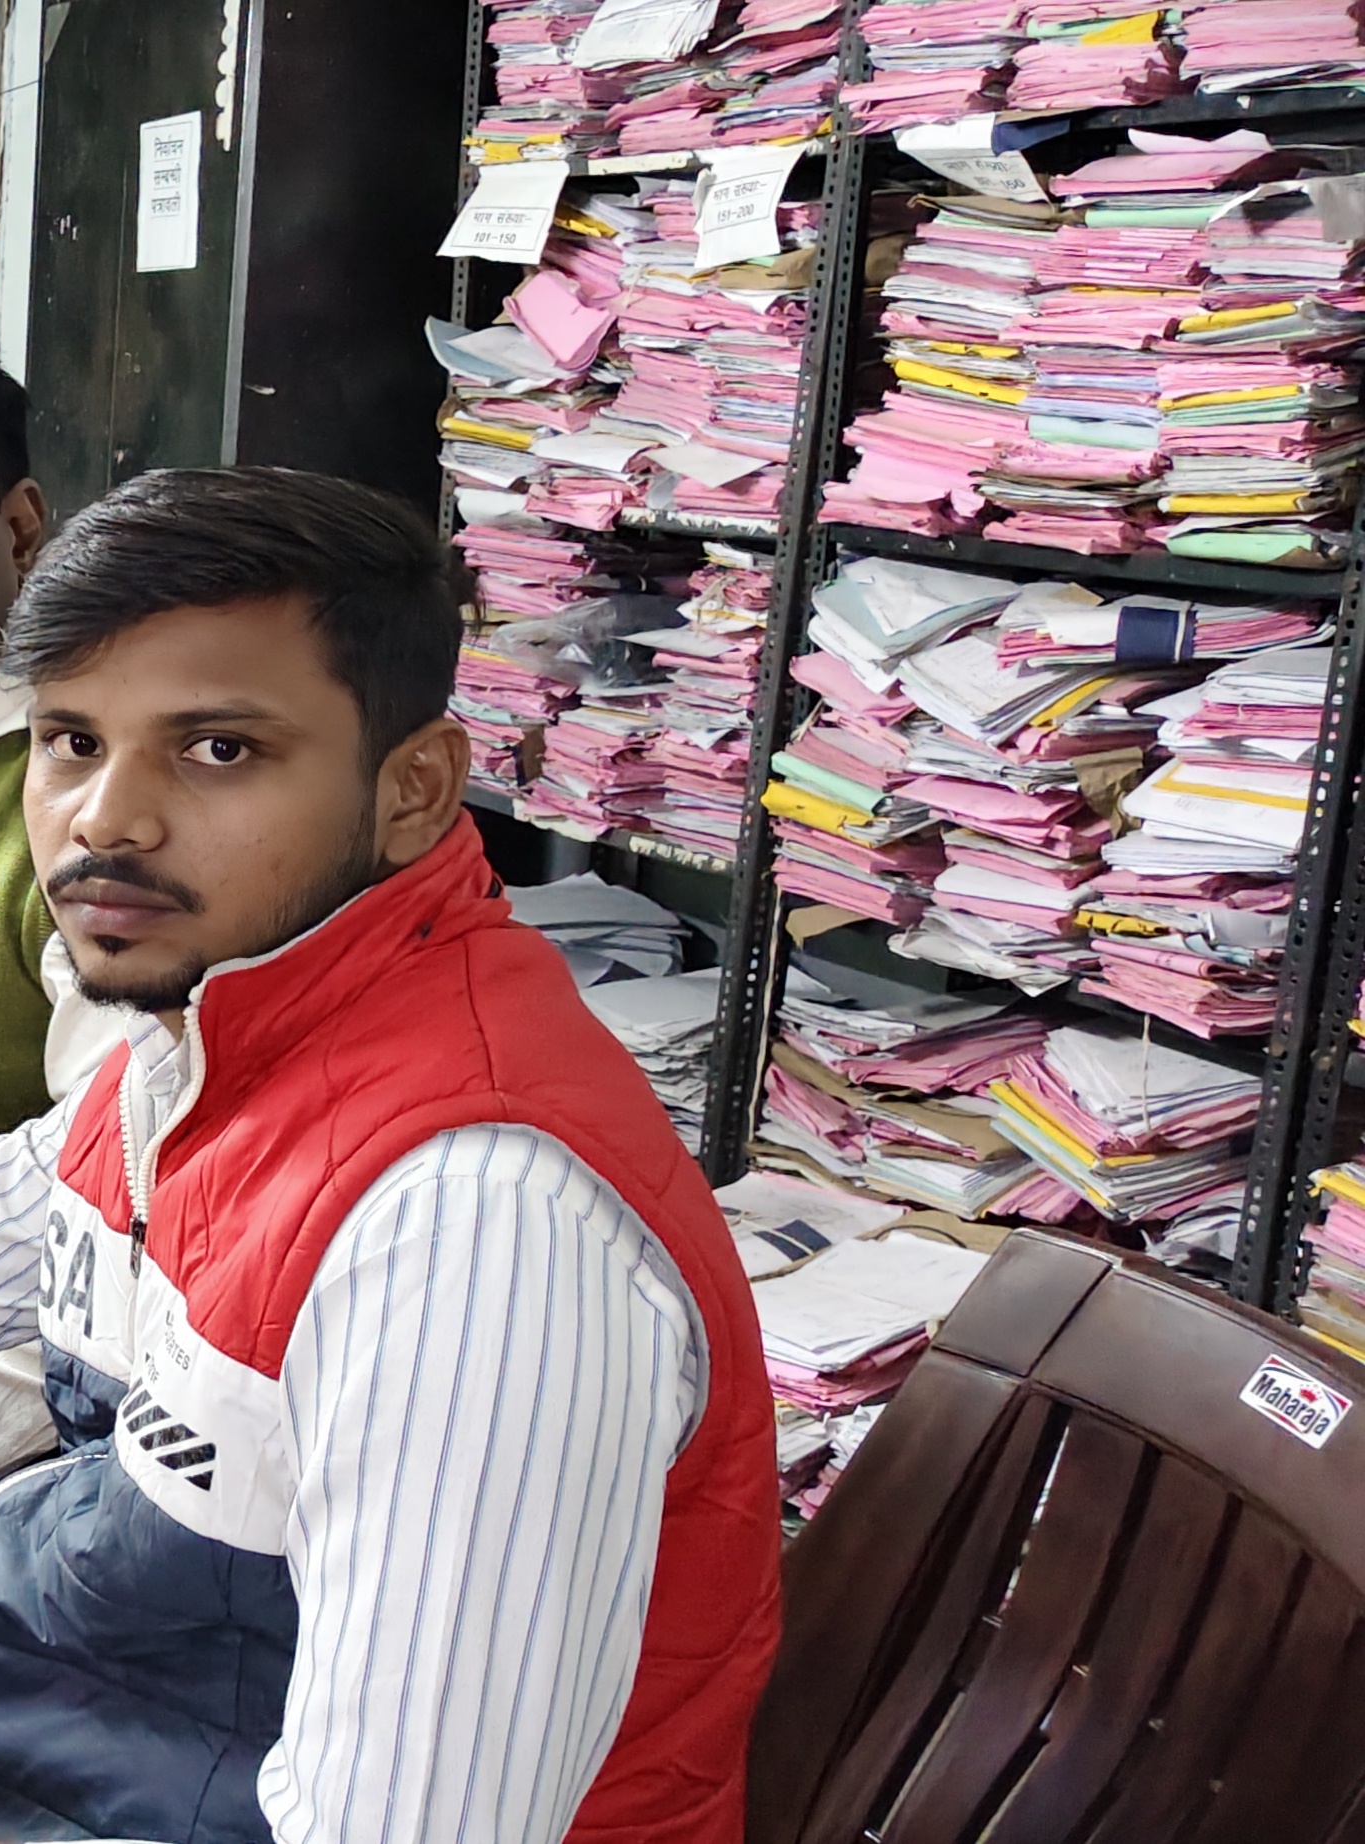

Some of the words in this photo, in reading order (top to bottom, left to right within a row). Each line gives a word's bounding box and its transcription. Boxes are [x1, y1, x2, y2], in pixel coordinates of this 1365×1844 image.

[716, 203, 755, 224] 151-200
[473, 231, 517, 245] 101-150
[1250, 1372, 1332, 1438] Maharaja
